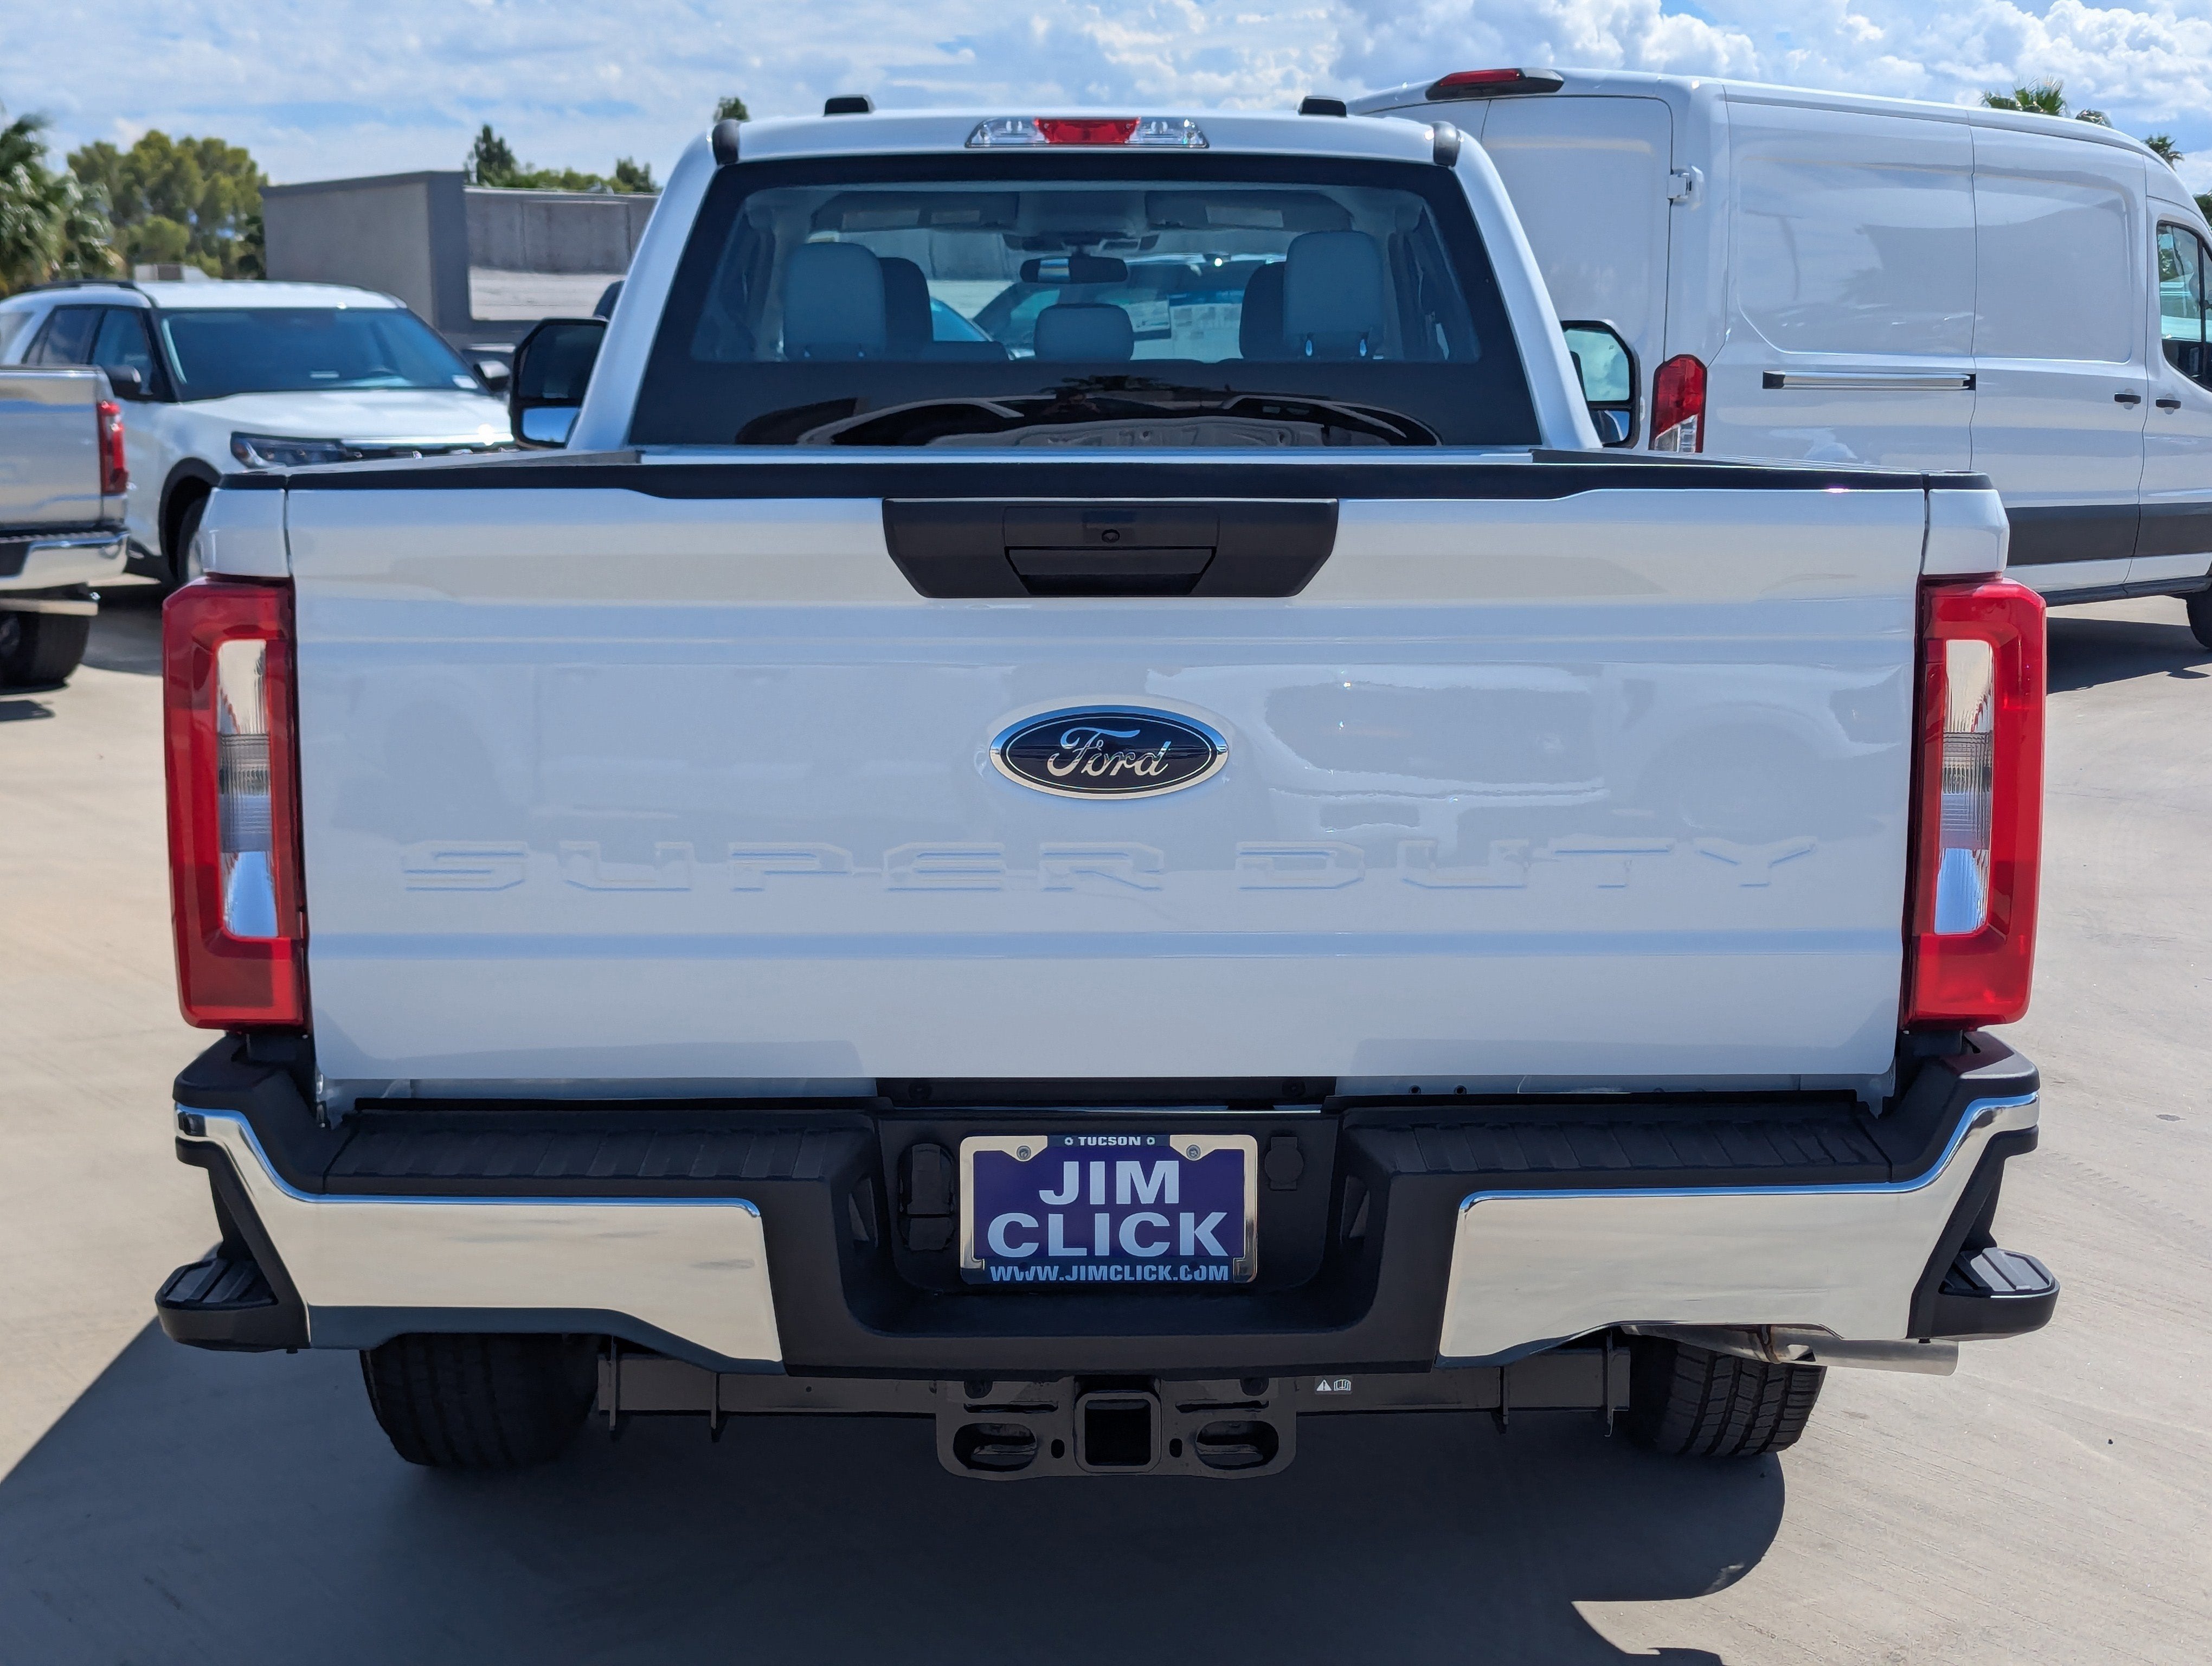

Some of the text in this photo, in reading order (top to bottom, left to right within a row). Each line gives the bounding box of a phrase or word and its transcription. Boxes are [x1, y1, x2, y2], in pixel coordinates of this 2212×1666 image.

[1047, 726, 1168, 777] Ford
[402, 836, 1819, 893] SUPER DUTY
[1078, 1136, 1141, 1146] TUCSON
[1038, 1160, 1179, 1205] JIM
[987, 1212, 1229, 1257] CLICK
[989, 1265, 1229, 1281] WWW.JIMCLICK.COM
